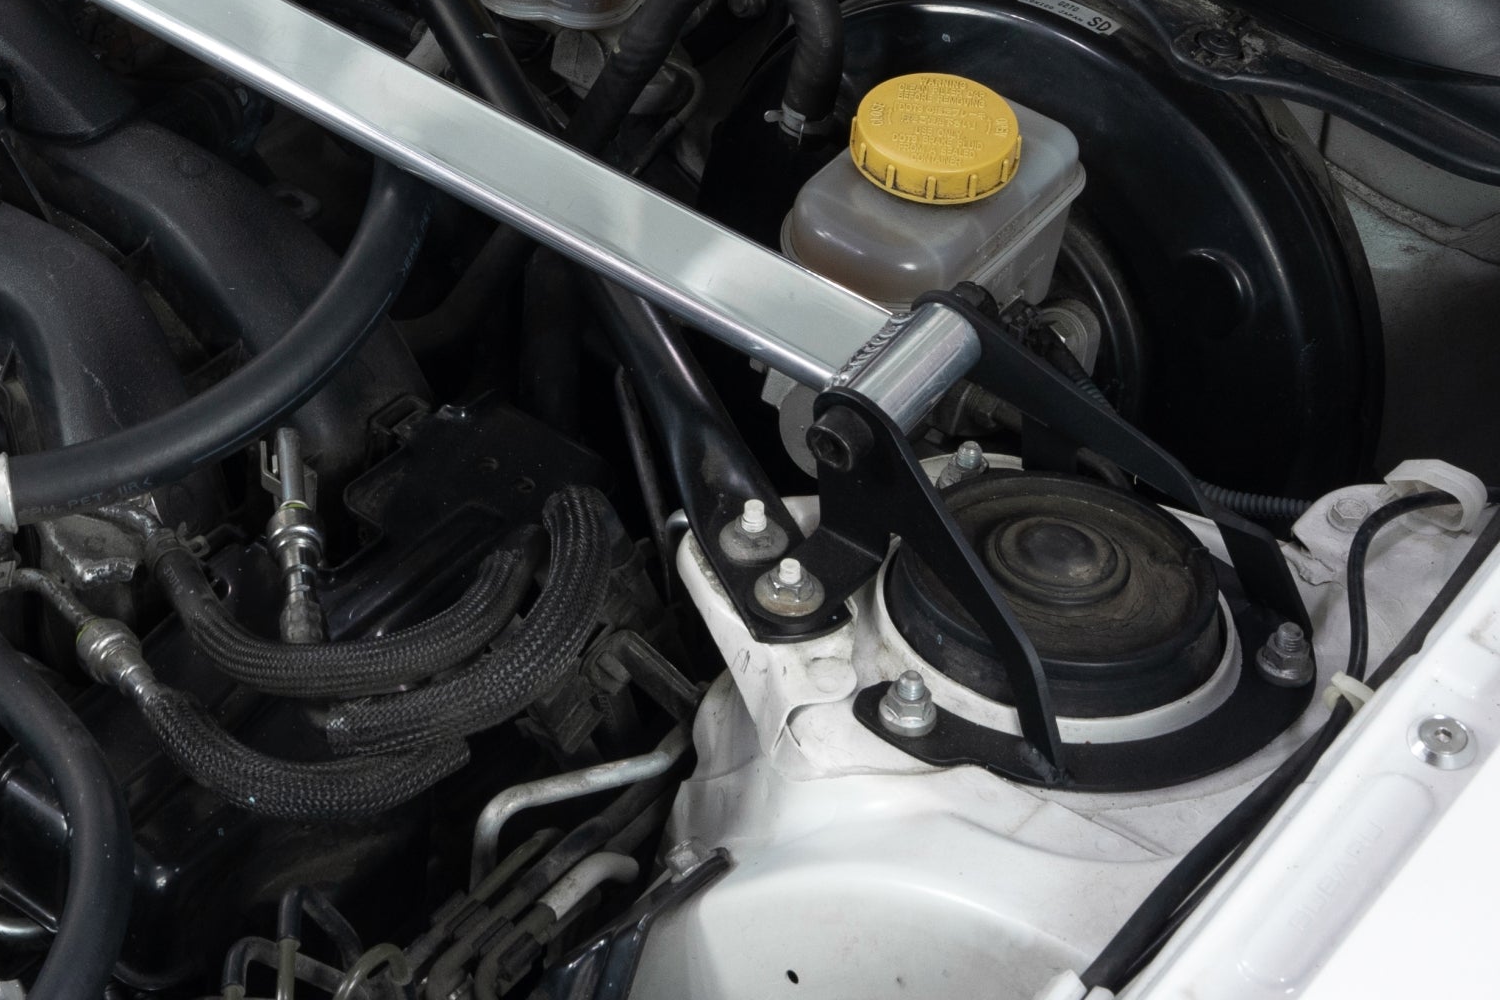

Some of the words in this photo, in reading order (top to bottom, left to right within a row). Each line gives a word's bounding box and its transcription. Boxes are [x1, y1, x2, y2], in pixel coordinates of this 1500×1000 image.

[1086, 14, 1113, 33] SD
[898, 83, 927, 94] CLEAN
[919, 77, 967, 89] WARNING
[897, 92, 932, 103] BEFORE
[936, 94, 986, 108] REMOVING
[921, 135, 952, 146] BRAKE
[956, 139, 983, 150] FLUID
[898, 142, 925, 153] FROM
[940, 147, 975, 159] SEALED
